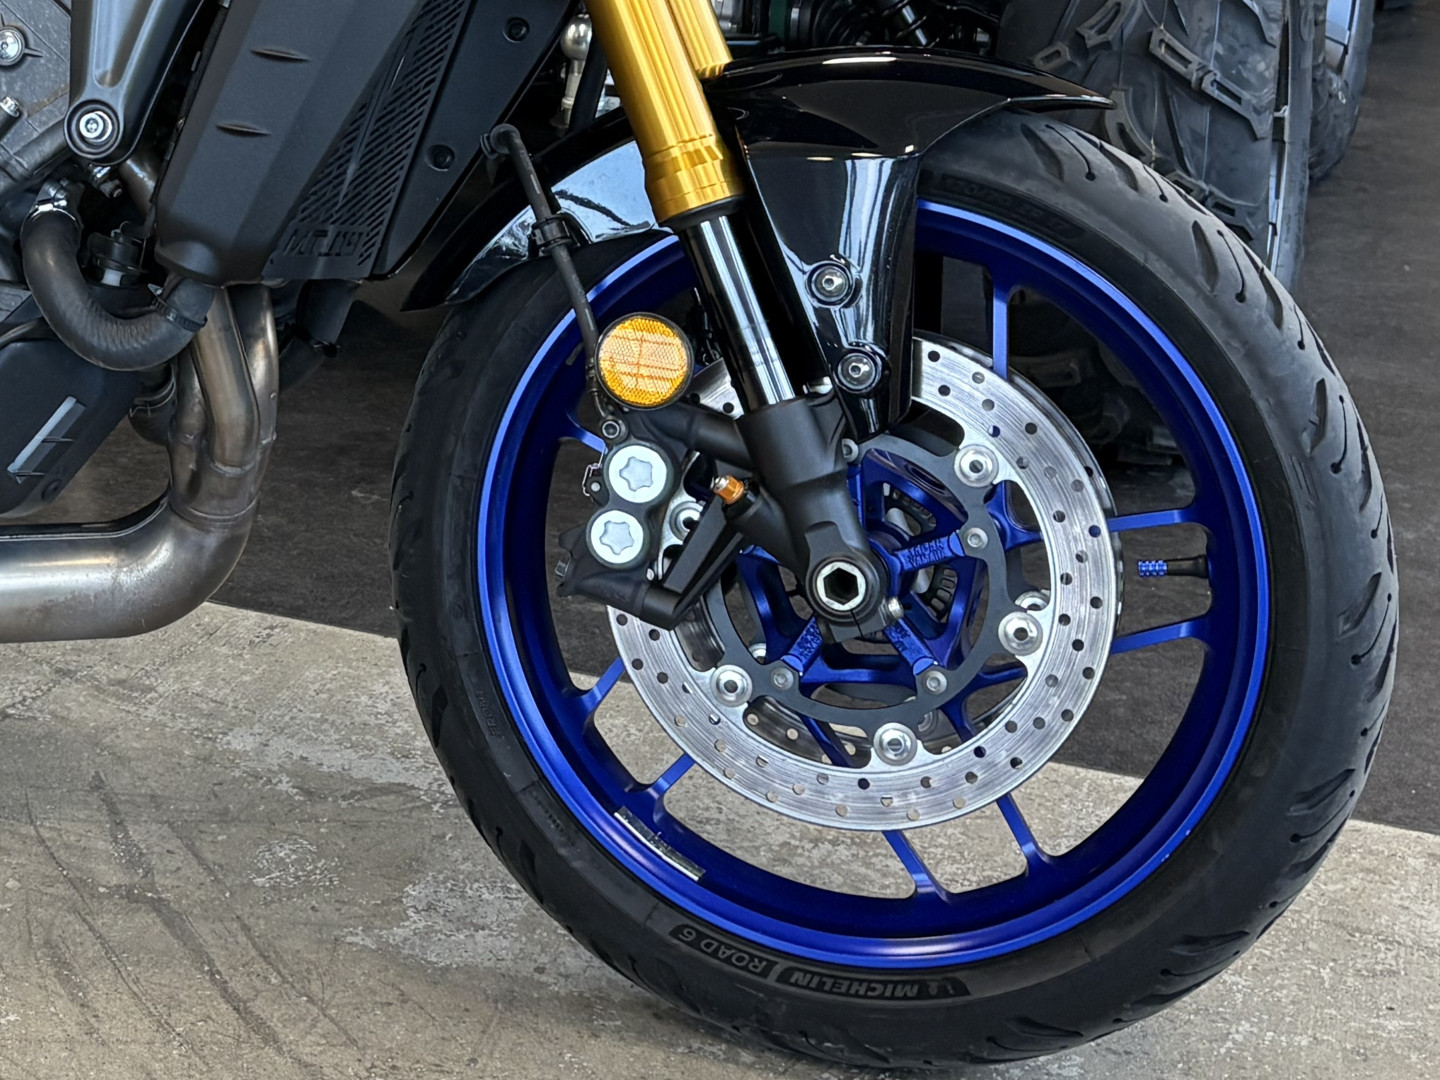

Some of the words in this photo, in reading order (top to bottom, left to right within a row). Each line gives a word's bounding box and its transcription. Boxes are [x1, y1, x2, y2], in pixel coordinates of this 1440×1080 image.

[678, 928, 698, 942] 6
[700, 941, 767, 971] ROAD
[789, 971, 918, 998] MICHELIN
